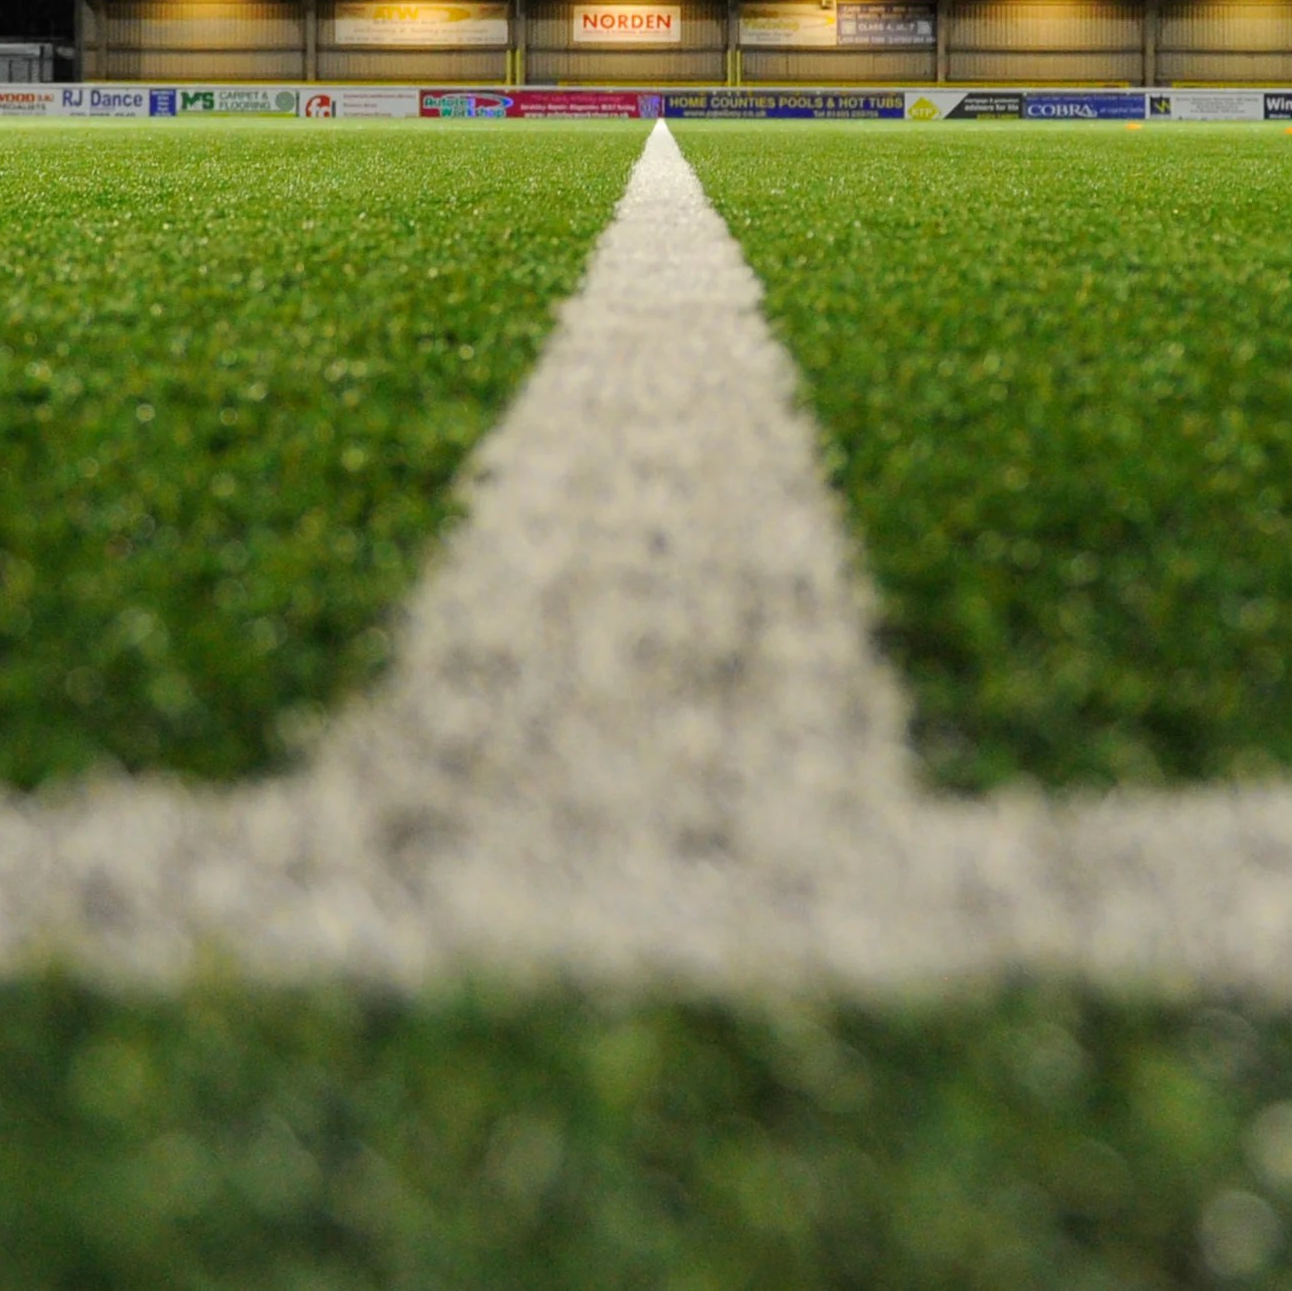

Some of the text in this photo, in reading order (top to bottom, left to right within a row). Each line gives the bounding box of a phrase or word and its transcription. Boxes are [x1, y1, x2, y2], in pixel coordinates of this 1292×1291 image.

[583, 14, 672, 29] NORDEN
[62, 89, 83, 107] RJ
[90, 89, 143, 107] Dance
[669, 97, 706, 108] HOME
[710, 97, 776, 109] COUNTIES
[779, 97, 823, 109] POOLS
[839, 97, 865, 109] HOT
[870, 97, 903, 109] TUBS
[1027, 103, 1095, 118] COBRA
